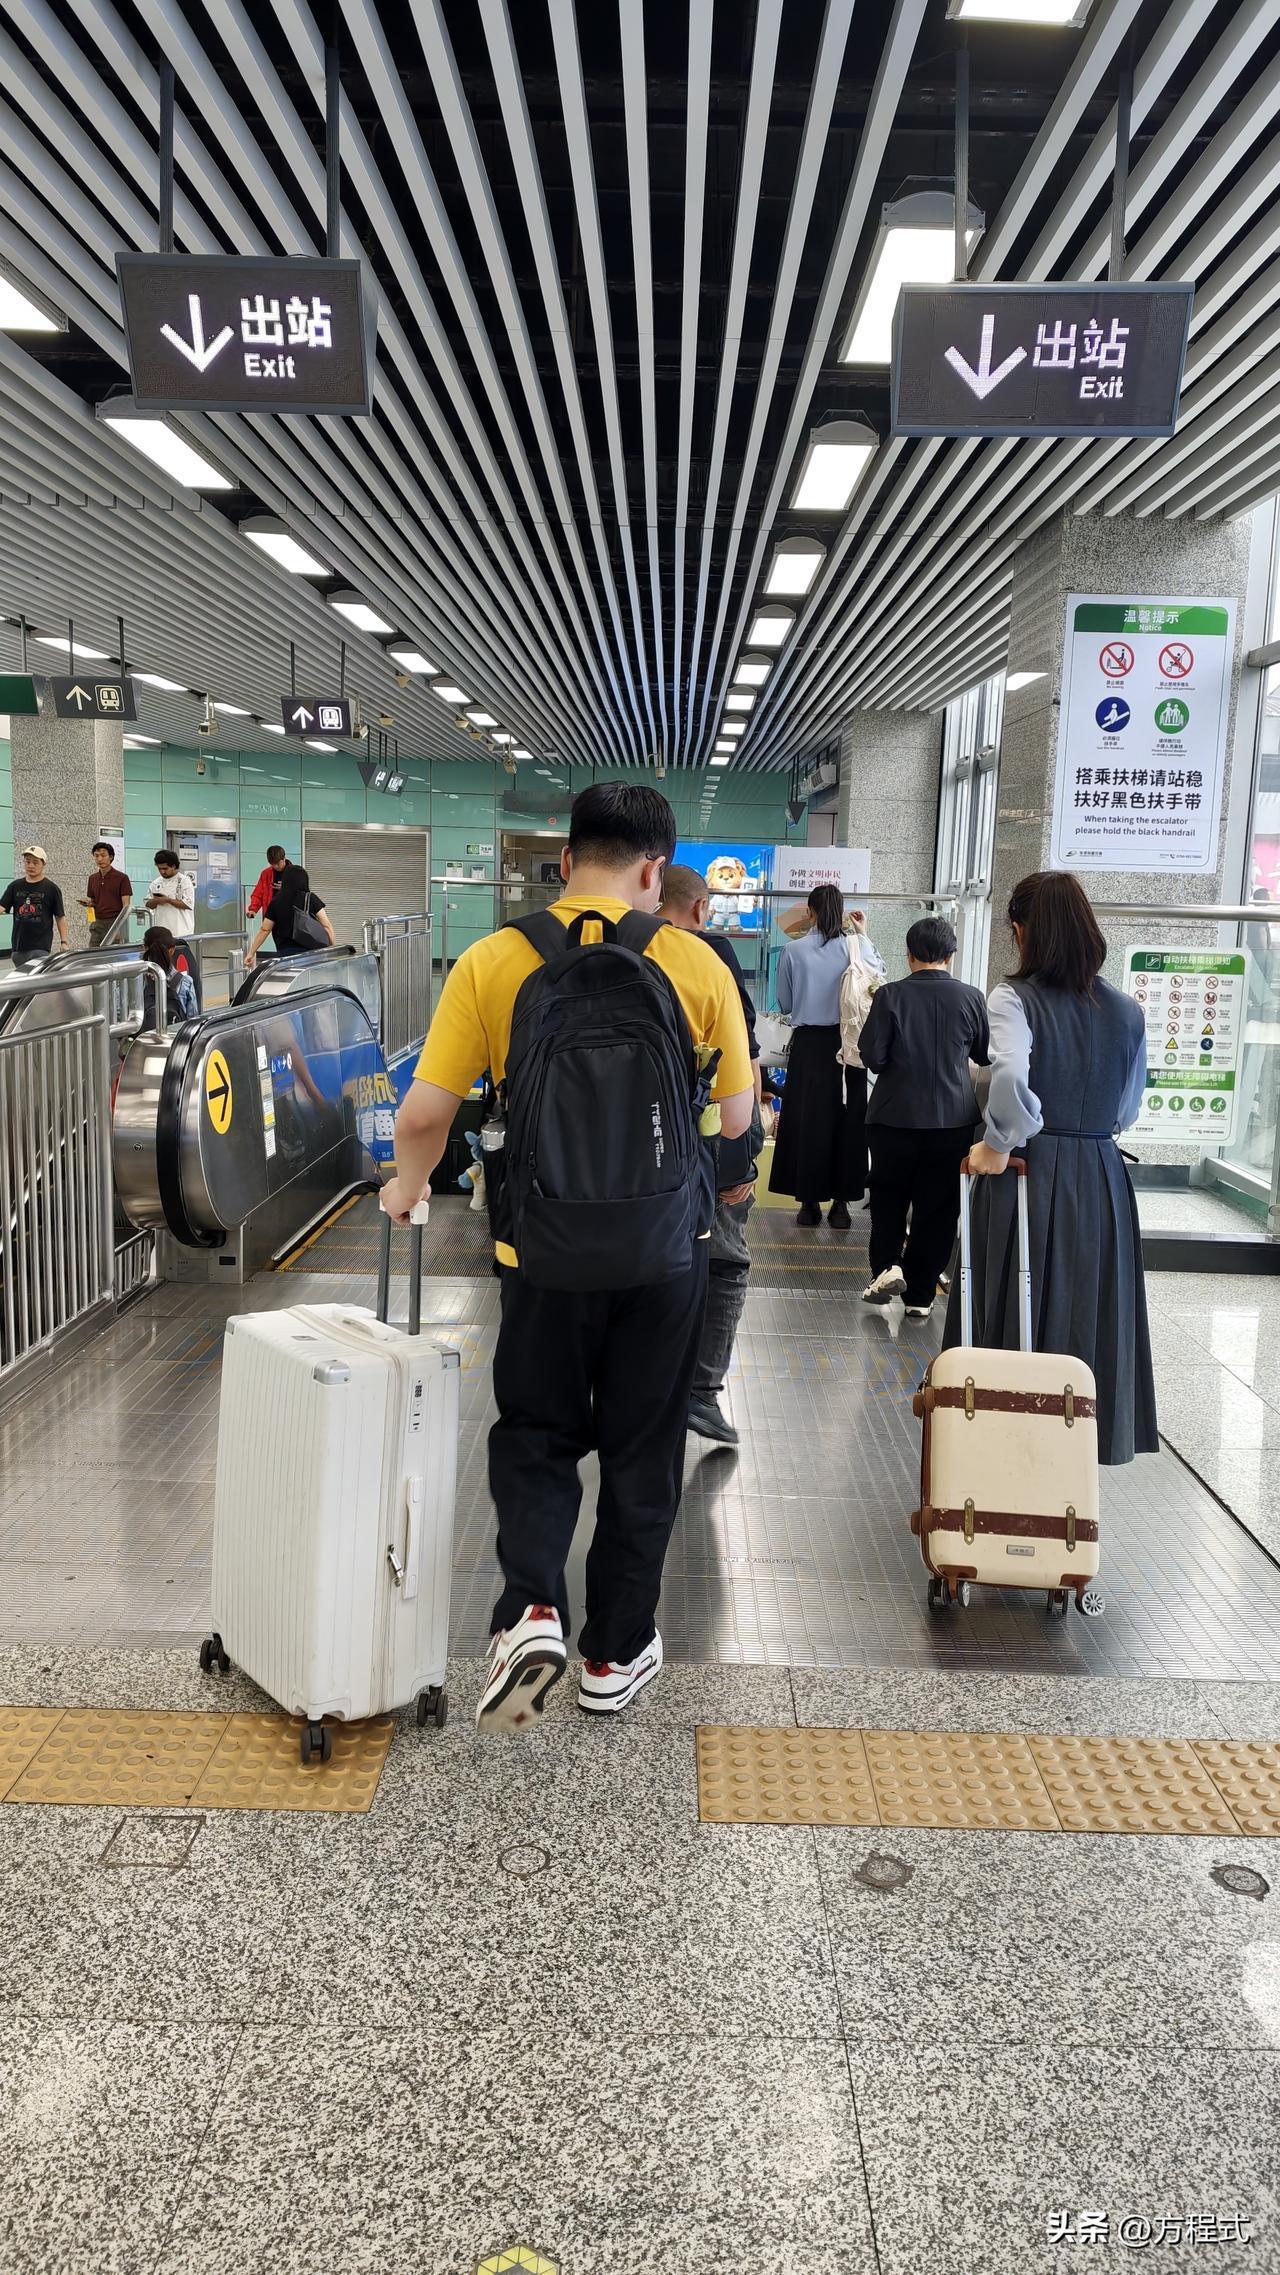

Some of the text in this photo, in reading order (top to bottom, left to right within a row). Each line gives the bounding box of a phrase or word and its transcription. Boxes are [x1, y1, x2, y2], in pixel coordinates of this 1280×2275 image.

[240, 294, 332, 348] 出站
[1032, 317, 1130, 369] 出站
[243, 353, 296, 379] Exit
[1079, 375, 1125, 400] Exit
[1123, 609, 1179, 624] 温馨提示
[1138, 624, 1162, 632] Notice
[1075, 767, 1203, 787] 搭乘扶梯请站稳
[1074, 790, 1202, 810] 扶好黑色扶手带
[1084, 815, 1188, 825] When taking the escalator
[1075, 827, 1196, 837] please hold the black handrail
[790, 868, 841, 879] 争做文明市民
